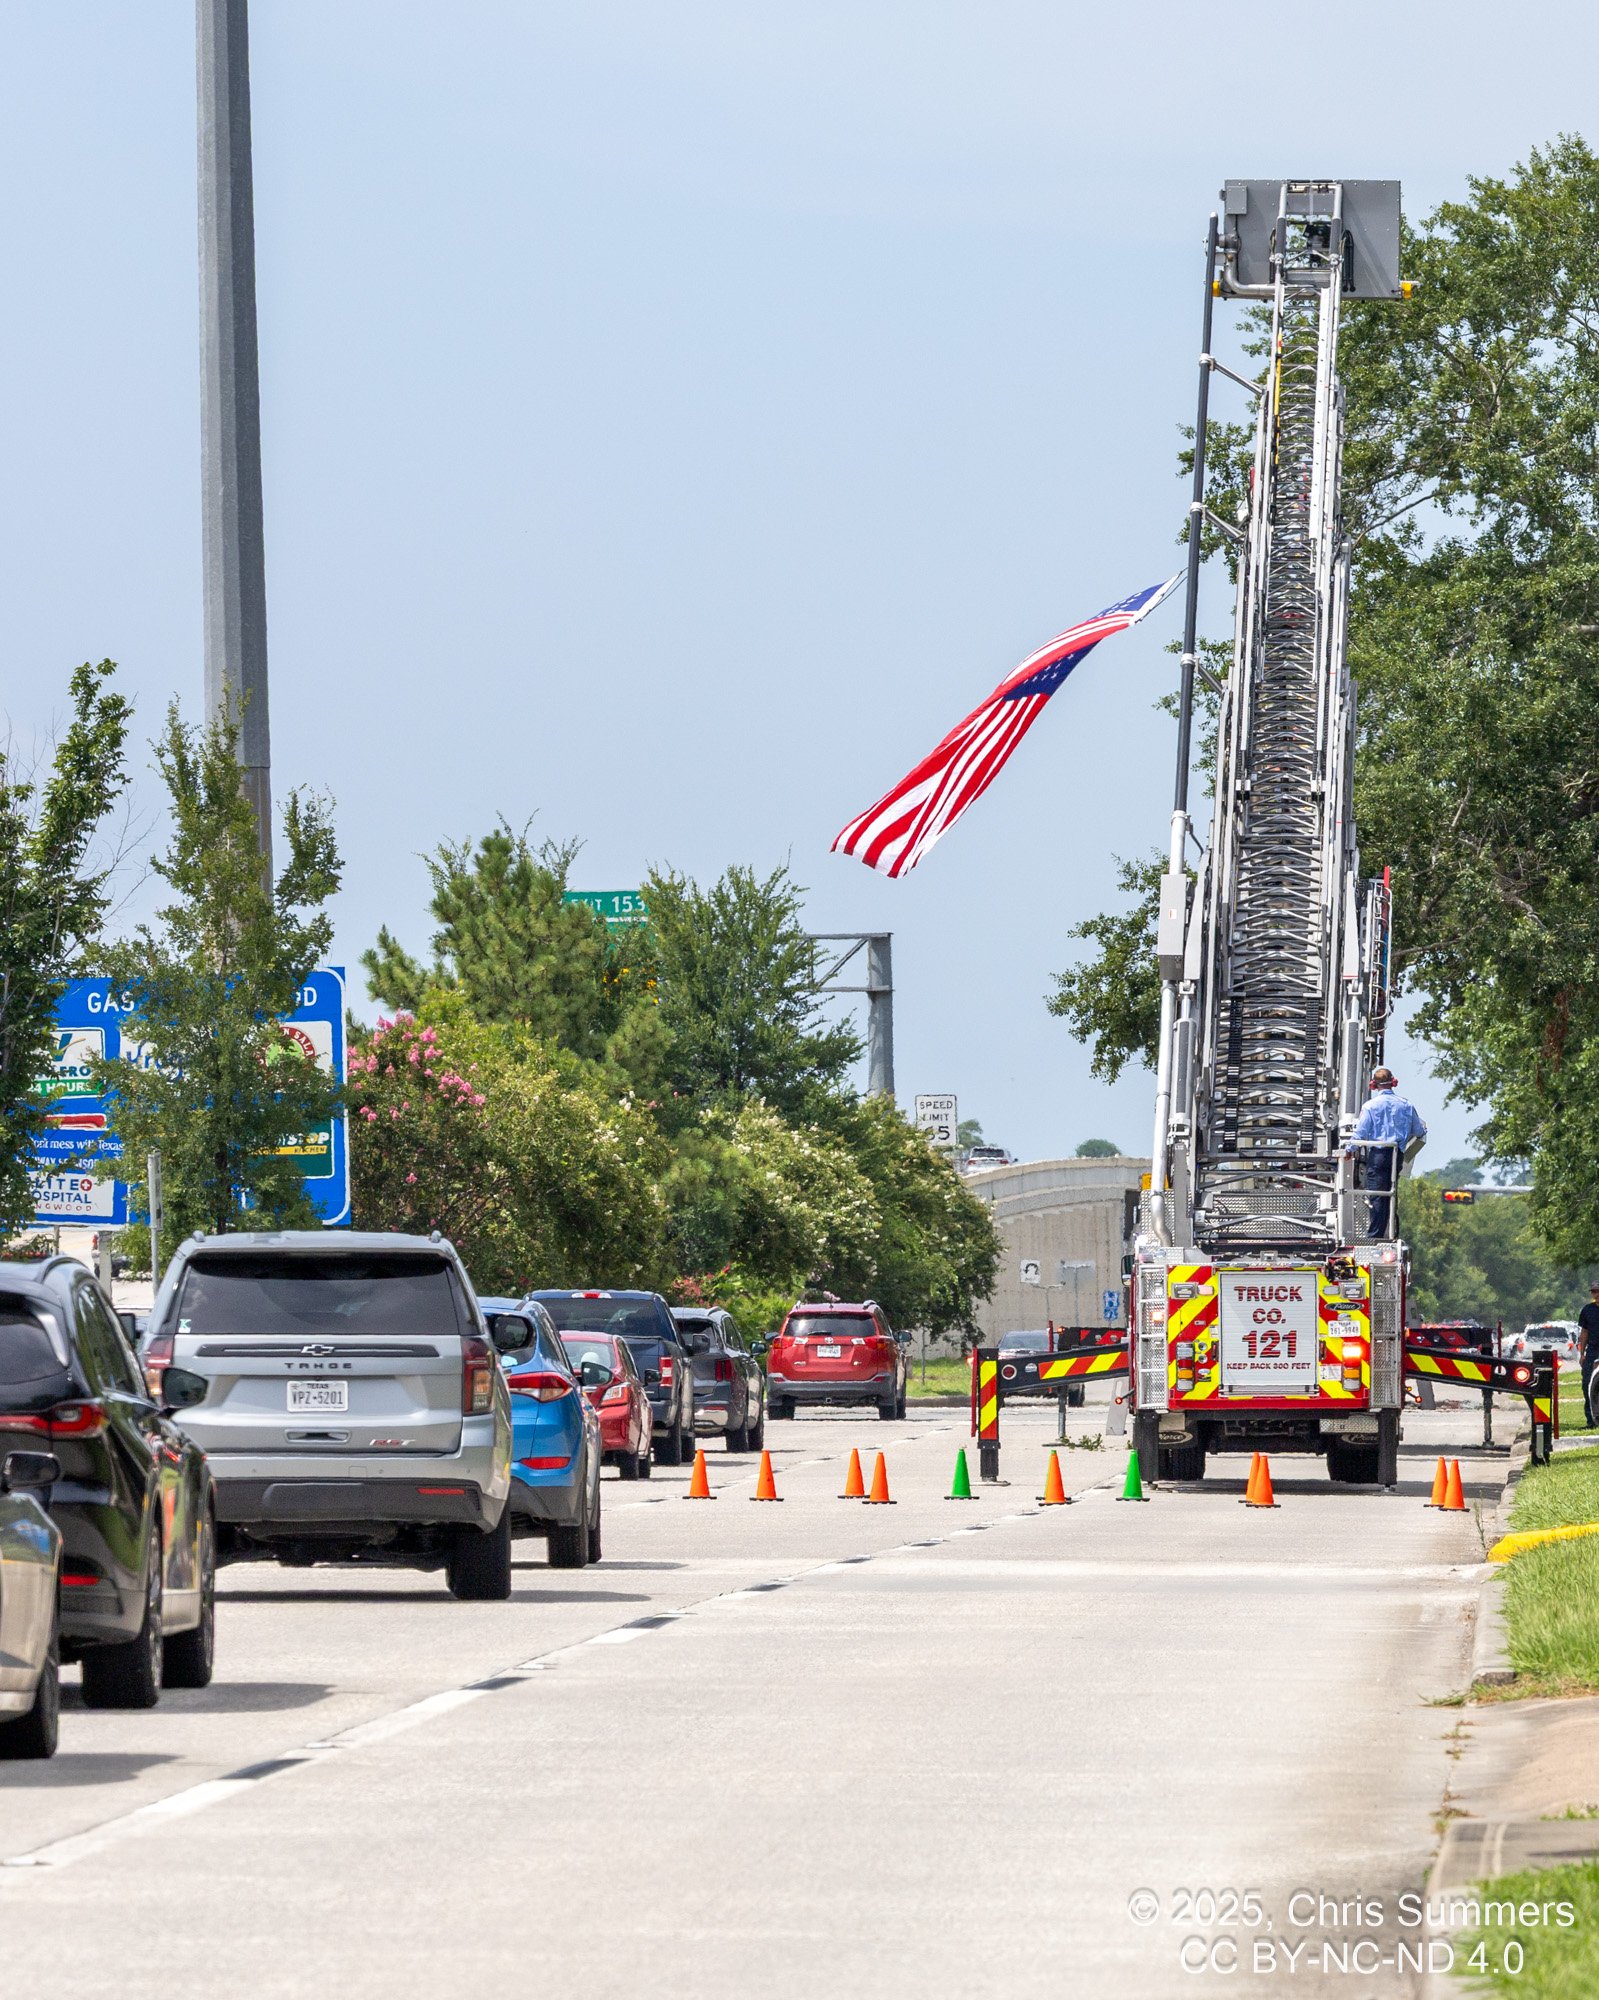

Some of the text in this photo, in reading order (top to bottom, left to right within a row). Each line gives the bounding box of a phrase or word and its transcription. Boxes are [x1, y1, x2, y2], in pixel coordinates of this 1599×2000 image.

[87, 991, 135, 1013] GAS
[293, 1030, 315, 1058] SALA
[919, 1100, 953, 1110] SPEED
[922, 1113, 950, 1122] LIMIT
[50, 1140, 75, 1150] mess
[34, 1178, 80, 1191] LITE
[31, 1191, 92, 1204] OSPITAL
[34, 1203, 92, 1212] NGWOOD
[1233, 1286, 1303, 1302] TRUCK
[1252, 1308, 1287, 1324] CO.
[1242, 1330, 1297, 1358] 121
